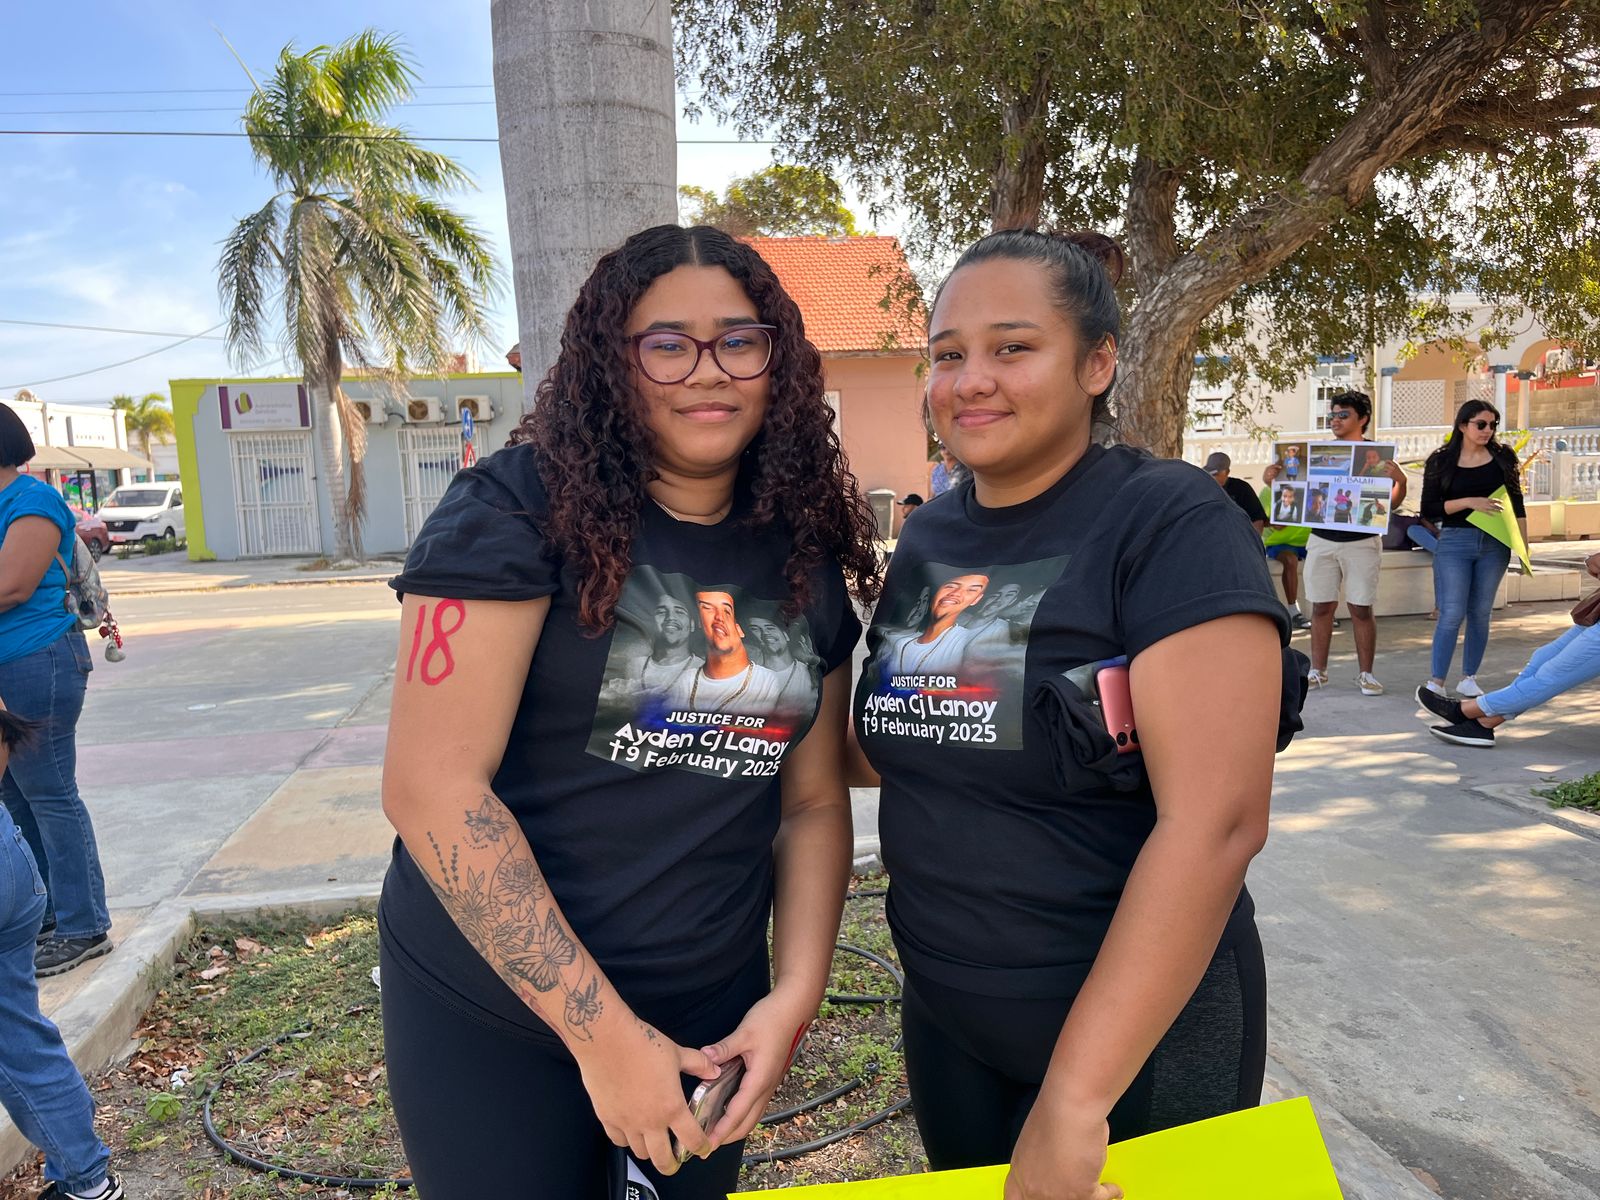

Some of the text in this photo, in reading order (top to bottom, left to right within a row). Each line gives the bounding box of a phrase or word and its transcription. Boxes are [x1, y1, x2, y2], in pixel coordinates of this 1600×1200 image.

[406, 598, 466, 686] 18
[890, 675, 957, 689] JUSTICE FOR
[665, 711, 766, 728] JUSTICE FOR
[864, 692, 998, 724] Ayden Cj Lanoy
[614, 722, 790, 760] Ayden Cj Lanoy
[881, 717, 945, 744] February
[948, 722, 997, 743] 2025
[643, 750, 739, 778] February
[741, 759, 781, 776] 2025
